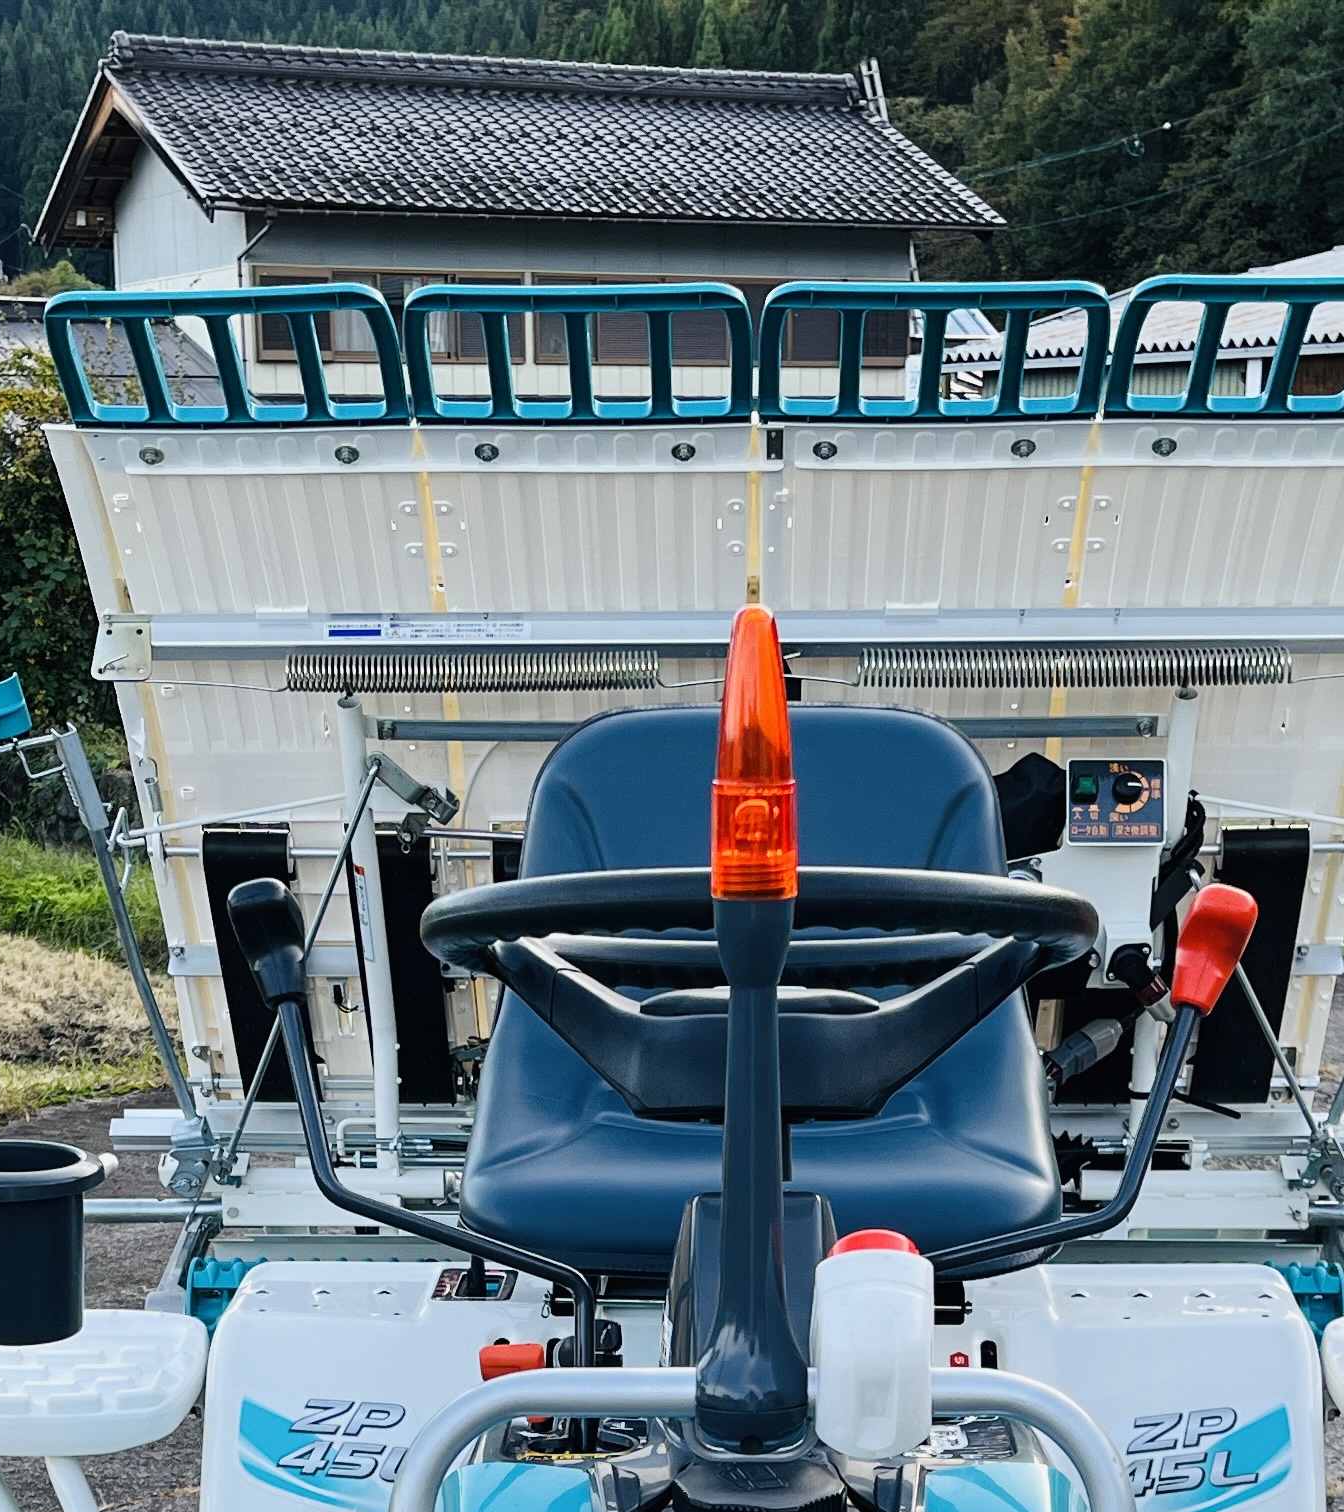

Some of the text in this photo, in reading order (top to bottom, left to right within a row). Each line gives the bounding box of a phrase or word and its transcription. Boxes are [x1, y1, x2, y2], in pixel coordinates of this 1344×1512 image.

[288, 1398, 406, 1437] ZP
[1126, 1407, 1238, 1455] ZP
[1125, 1450, 1259, 1498] 45L
